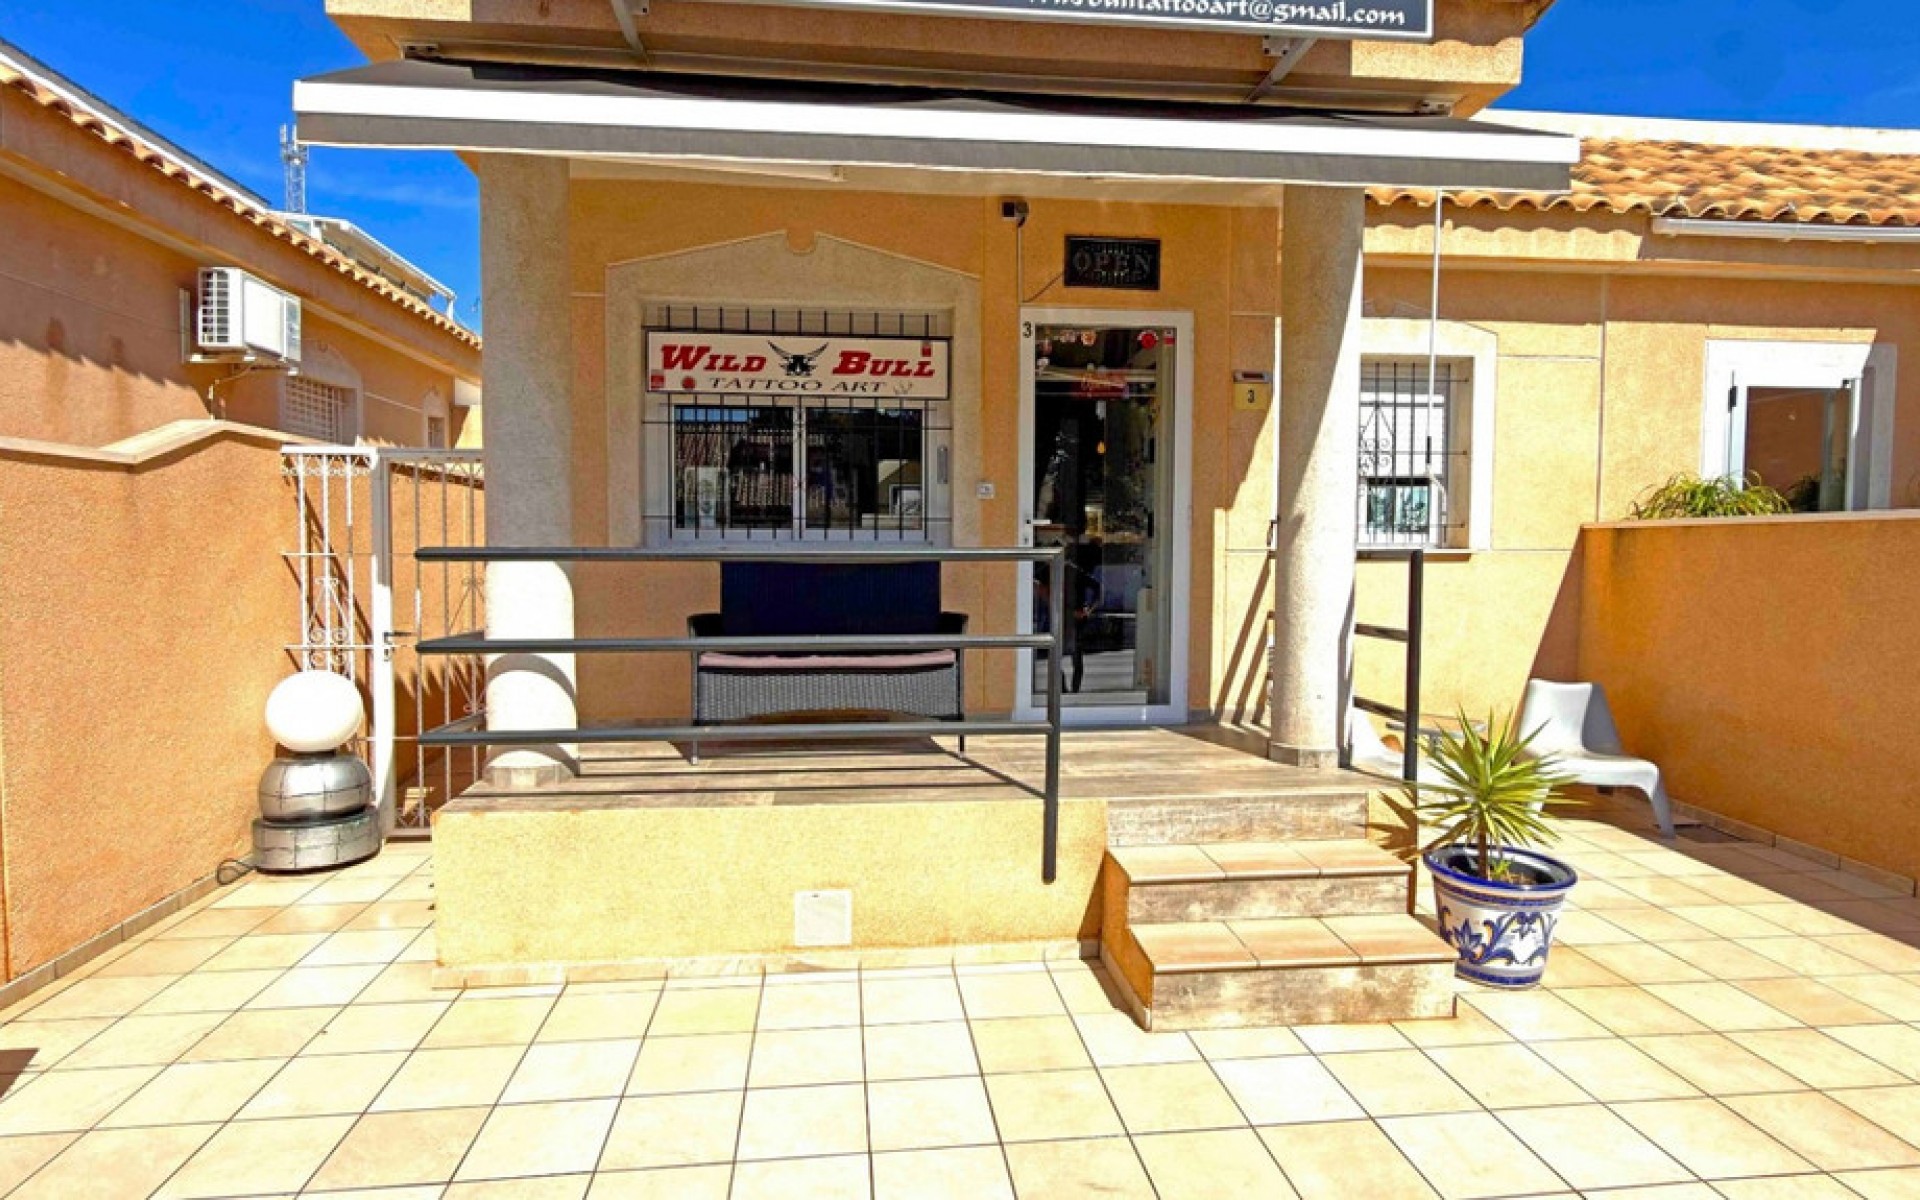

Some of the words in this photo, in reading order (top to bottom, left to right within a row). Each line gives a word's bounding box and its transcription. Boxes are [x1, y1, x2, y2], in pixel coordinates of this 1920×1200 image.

[1073, 249, 1153, 275] OPEN
[1022, 320, 1032, 338] 3
[709, 378, 822, 391] TATTOO
[831, 381, 887, 393] ART
[1247, 389, 1255, 404] 3
